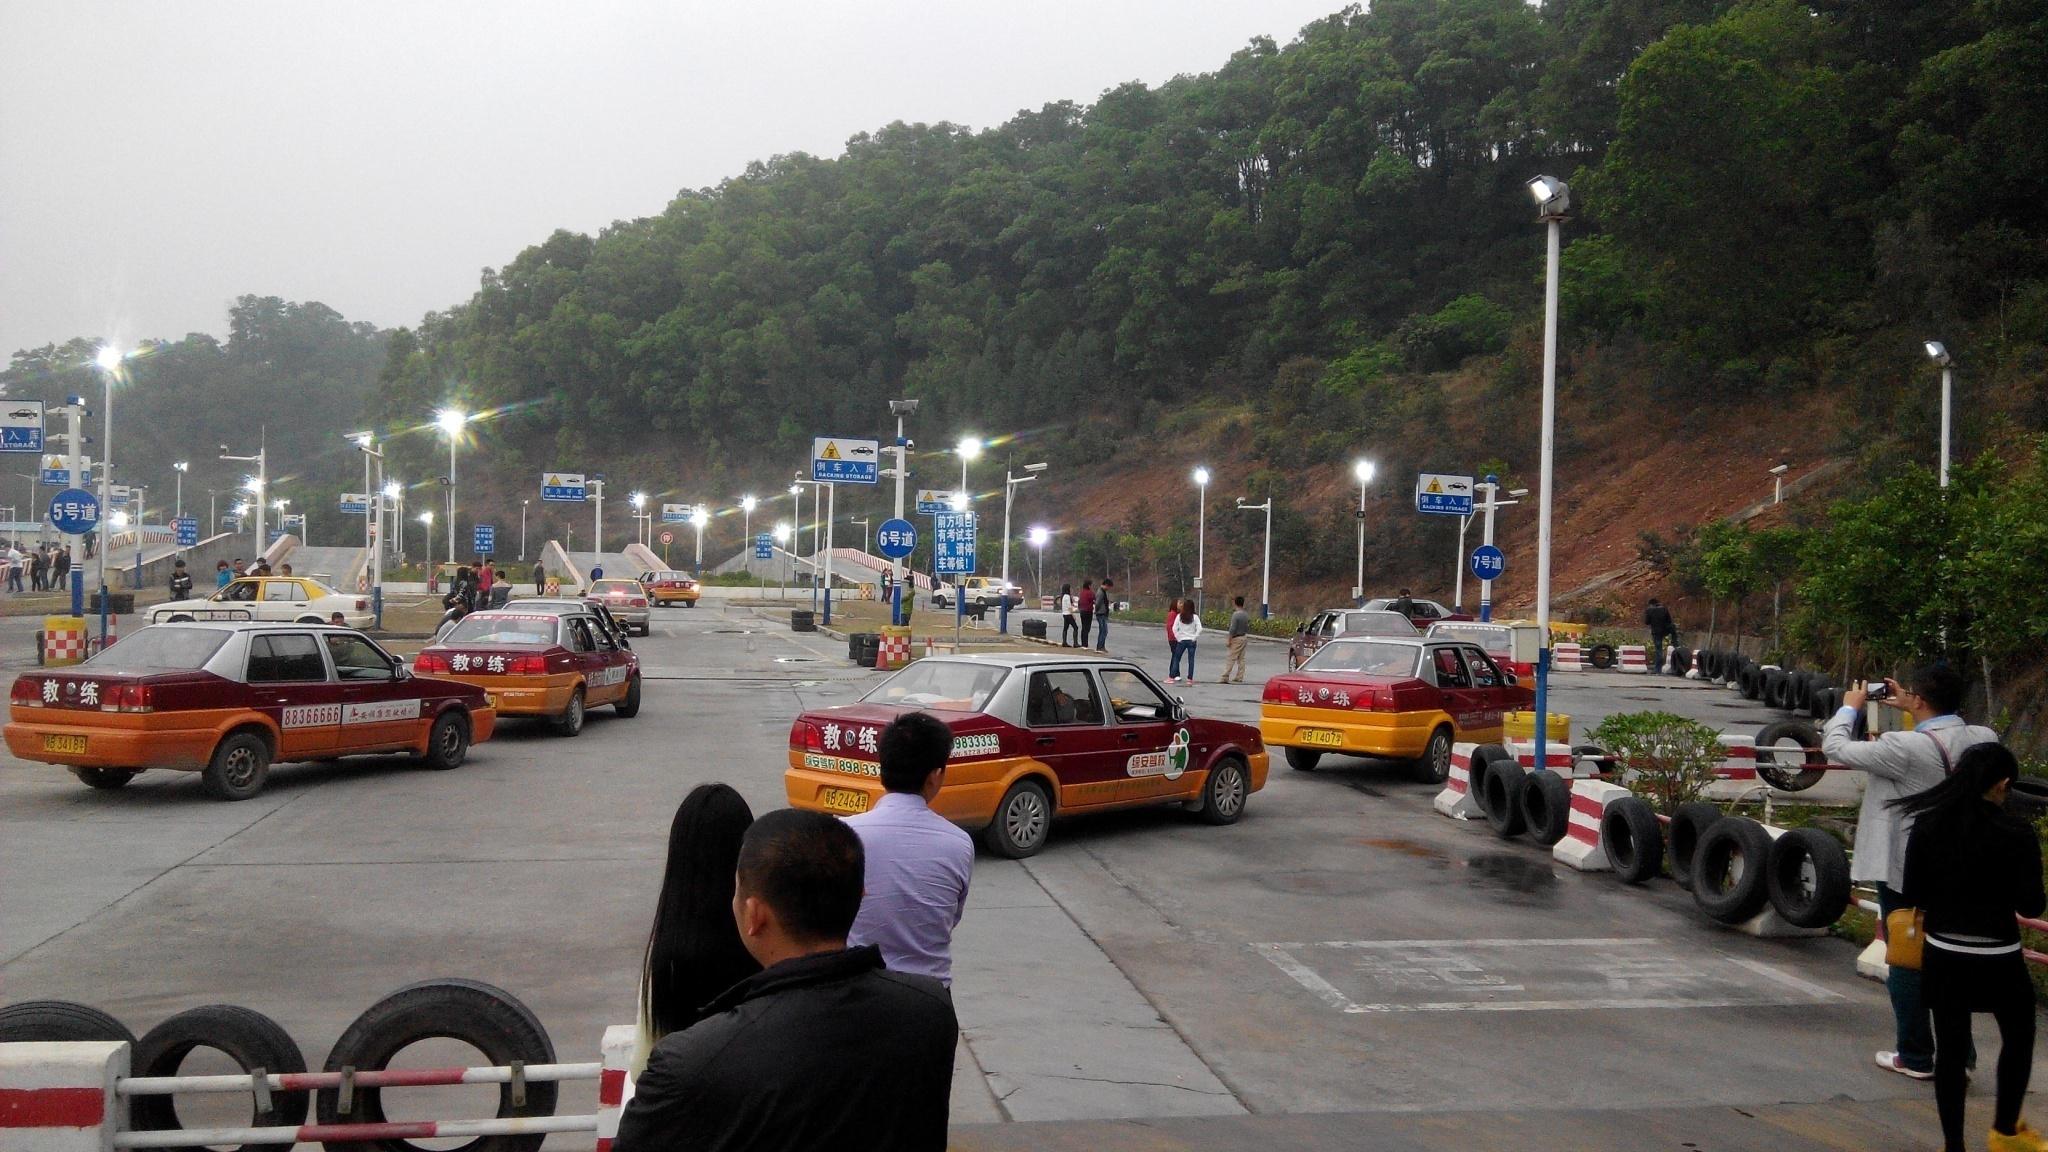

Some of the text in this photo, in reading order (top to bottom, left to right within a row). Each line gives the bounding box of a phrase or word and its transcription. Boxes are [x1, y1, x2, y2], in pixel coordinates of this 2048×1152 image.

[816, 462, 875, 474] 倒车入库
[1421, 495, 1470, 506] 倒车入库
[53, 502, 96, 520] 5号道
[937, 513, 973, 528] 前方项目
[879, 530, 914, 548] 6号道
[937, 528, 973, 542] 有考试车
[1473, 555, 1502, 570] 7号道
[284, 706, 339, 726] 88366666
[839, 759, 860, 775] 898
